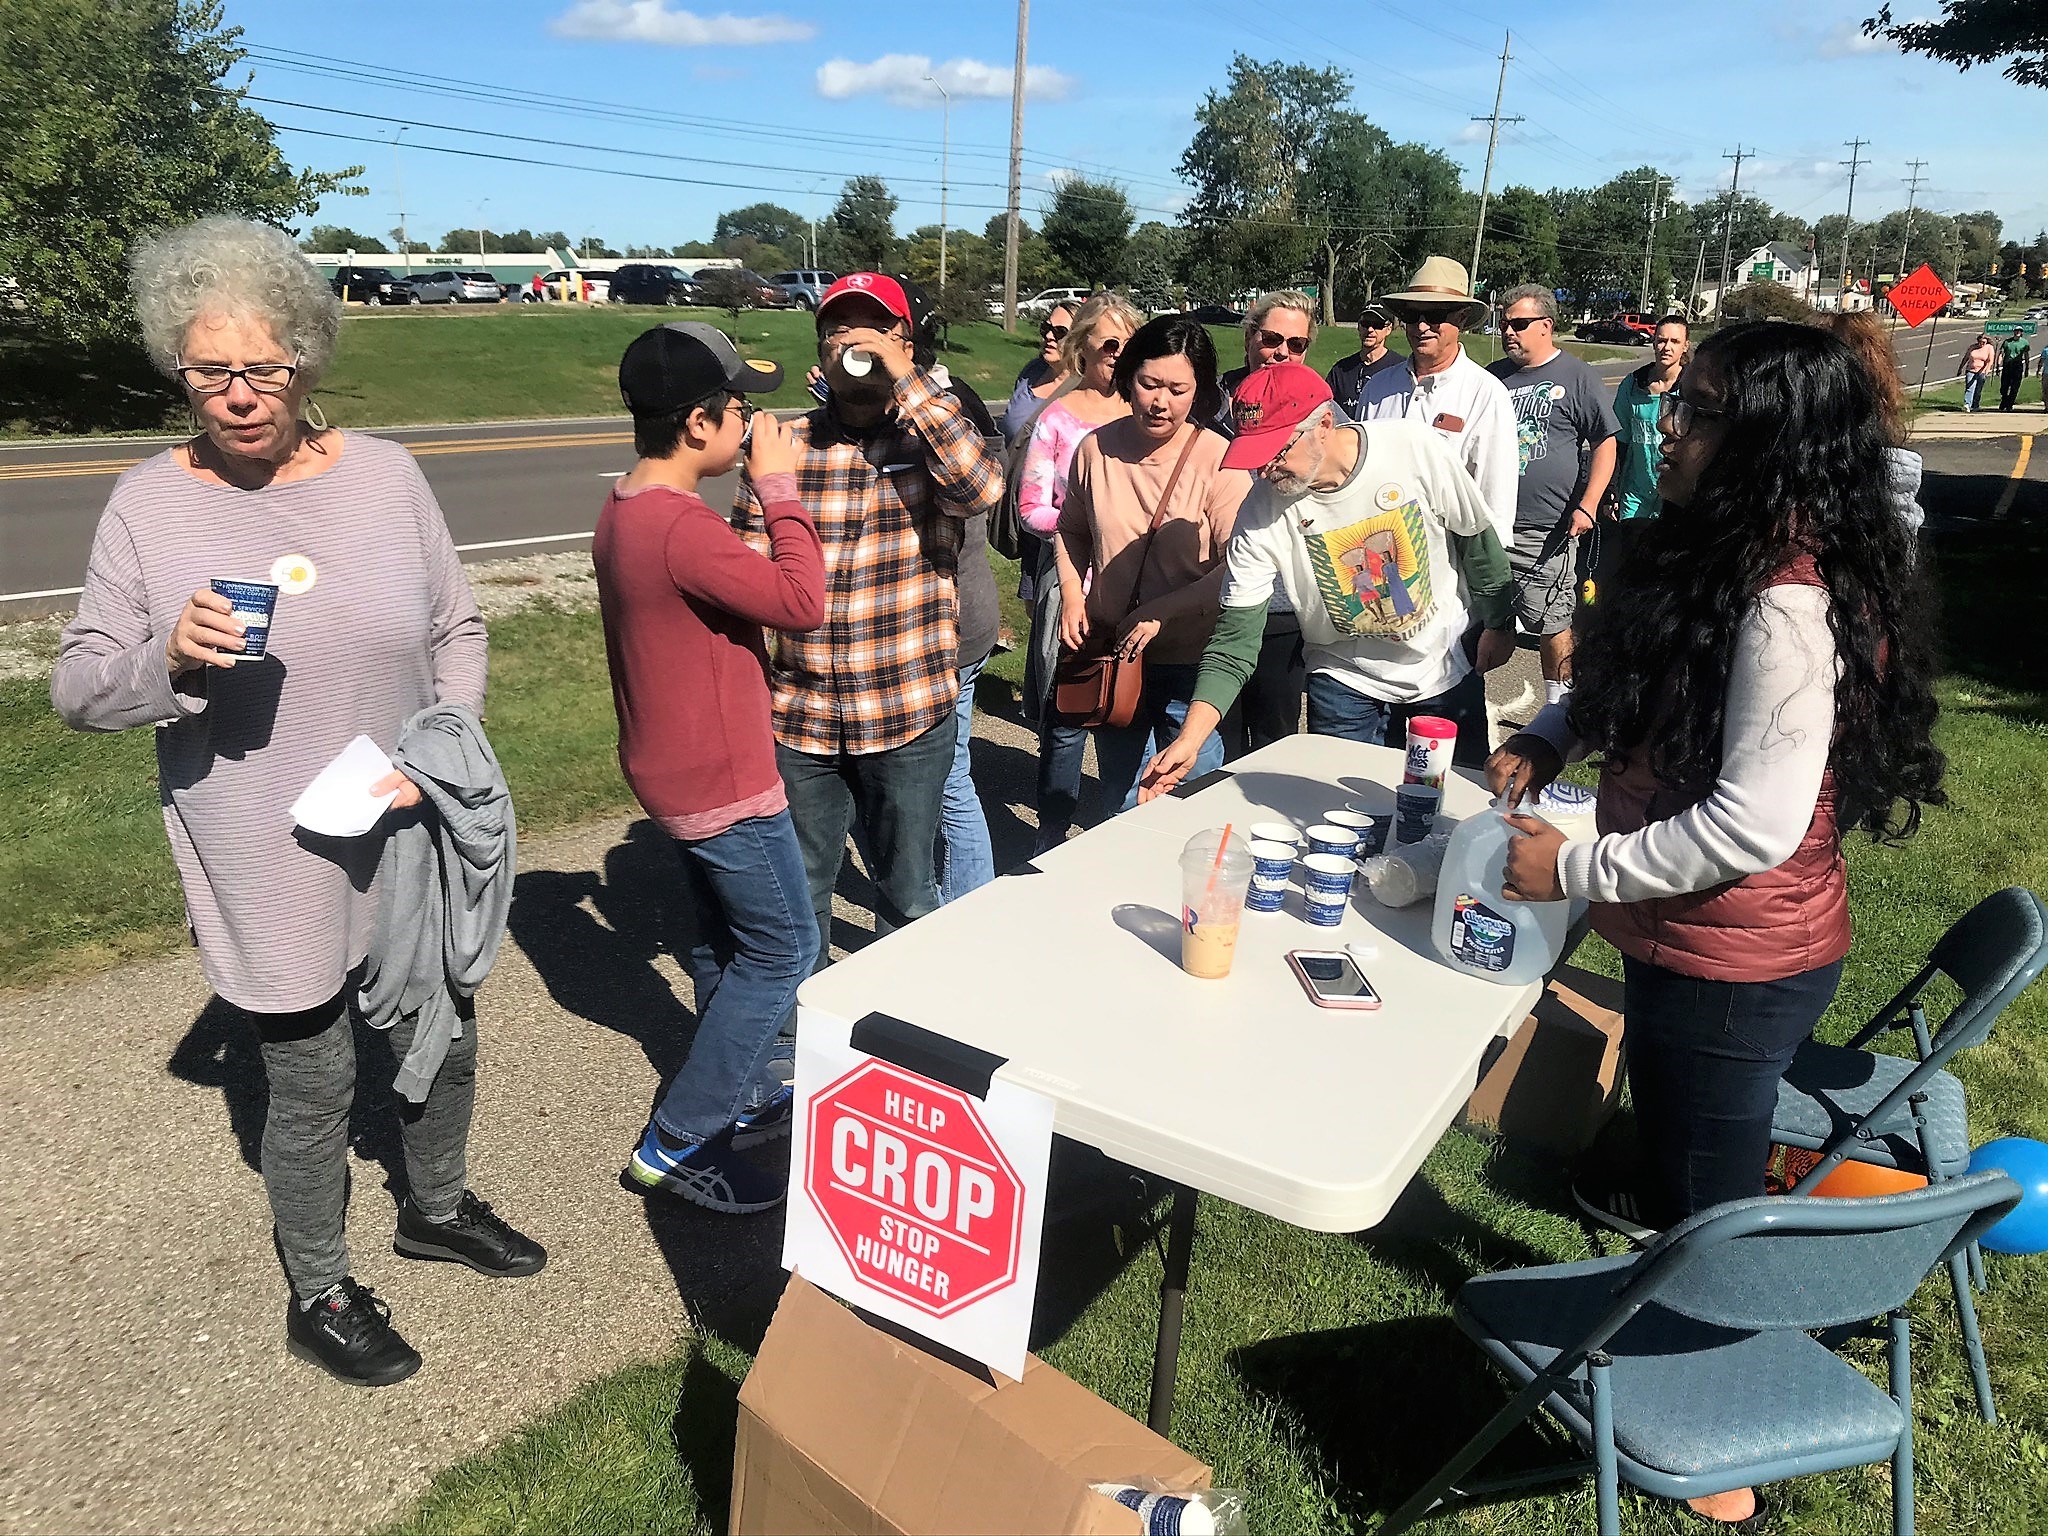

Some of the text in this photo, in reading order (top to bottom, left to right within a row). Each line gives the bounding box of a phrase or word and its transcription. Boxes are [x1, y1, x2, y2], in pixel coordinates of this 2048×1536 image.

[1900, 299, 1937, 309] AHEAD
[1901, 286, 1942, 296] DETOUR
[1465, 937, 1506, 954] SPRING WATER
[884, 1089, 946, 1134] HELP
[831, 1116, 996, 1236] CROP
[879, 1215, 940, 1260] STOP
[855, 1234, 951, 1301] HUNGER
